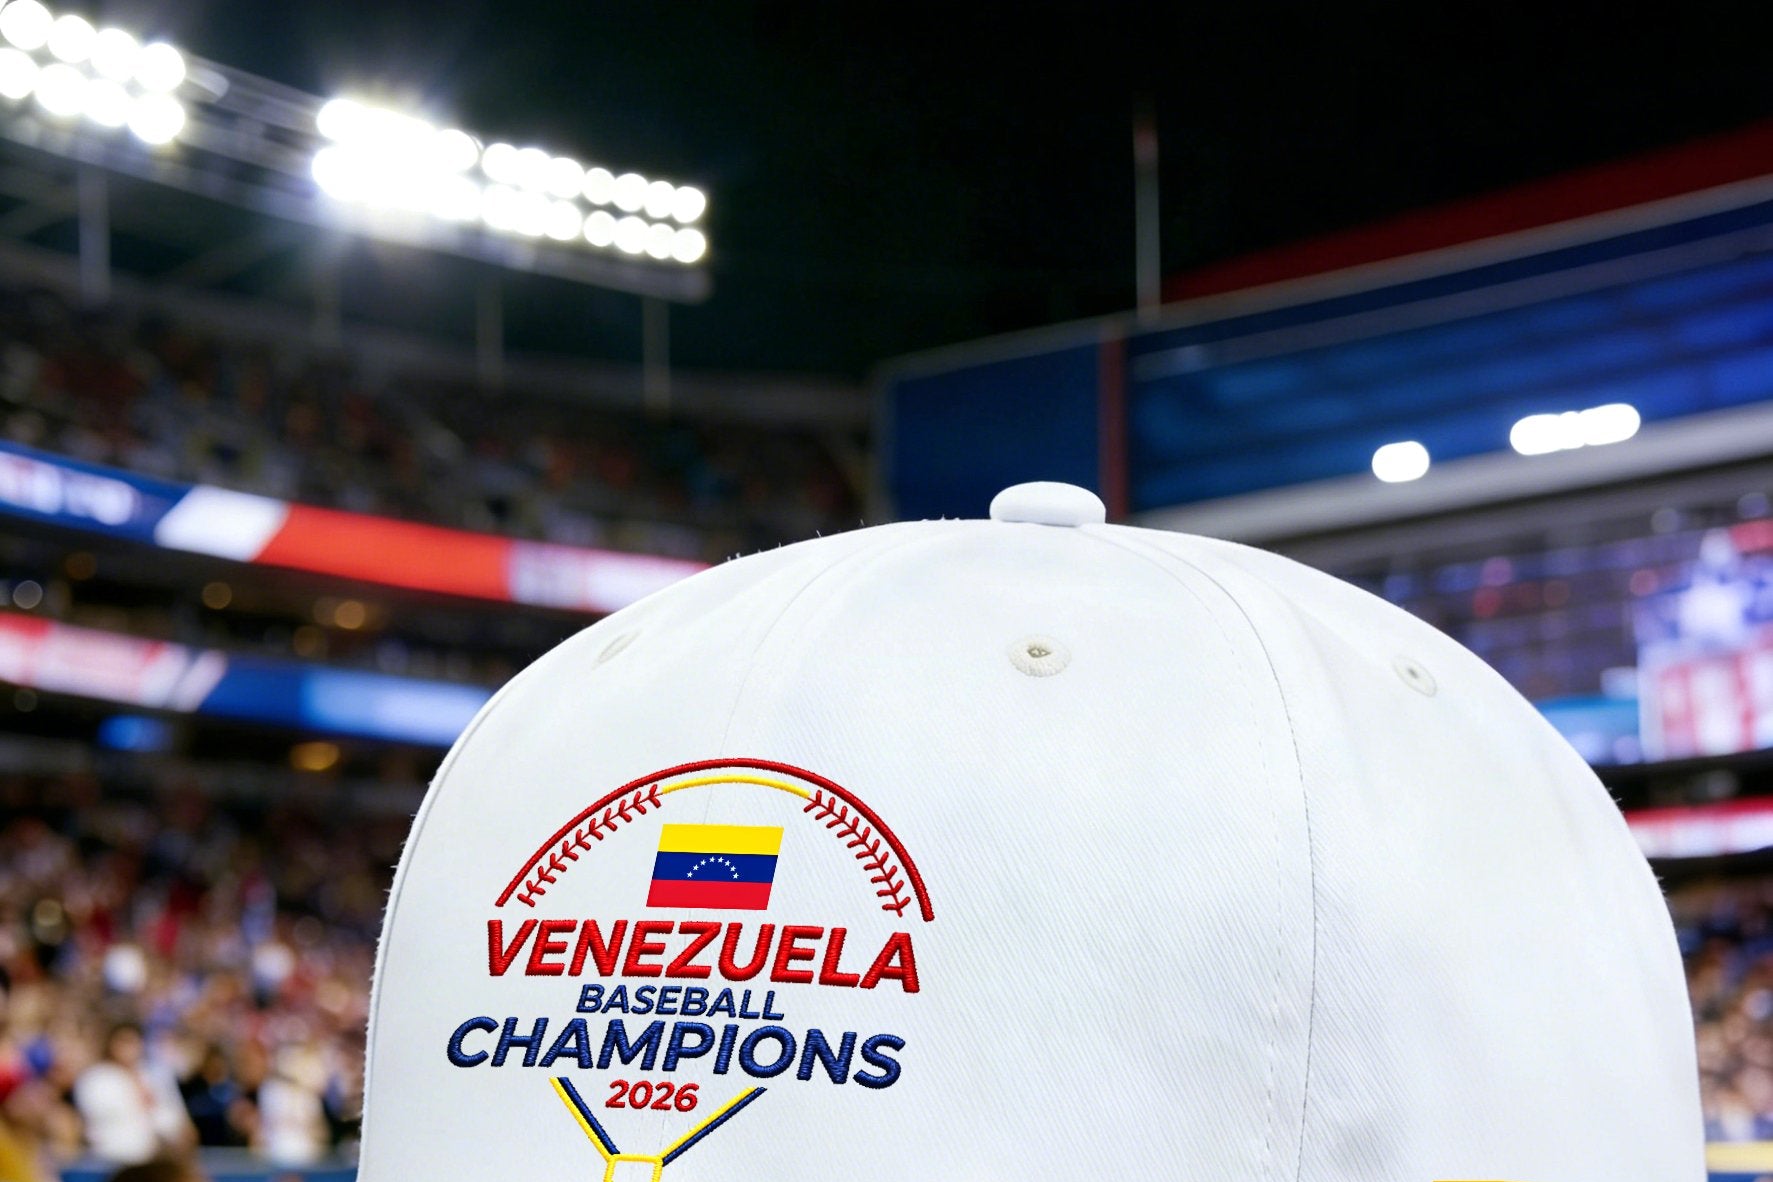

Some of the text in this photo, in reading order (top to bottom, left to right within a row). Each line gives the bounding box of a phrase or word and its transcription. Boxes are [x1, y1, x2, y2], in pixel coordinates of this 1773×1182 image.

[487, 920, 920, 993] VENEZUELA
[576, 984, 784, 1021] BASEBALL
[446, 1016, 906, 1090] CHAMPIONS
[605, 1079, 700, 1112] 2026
